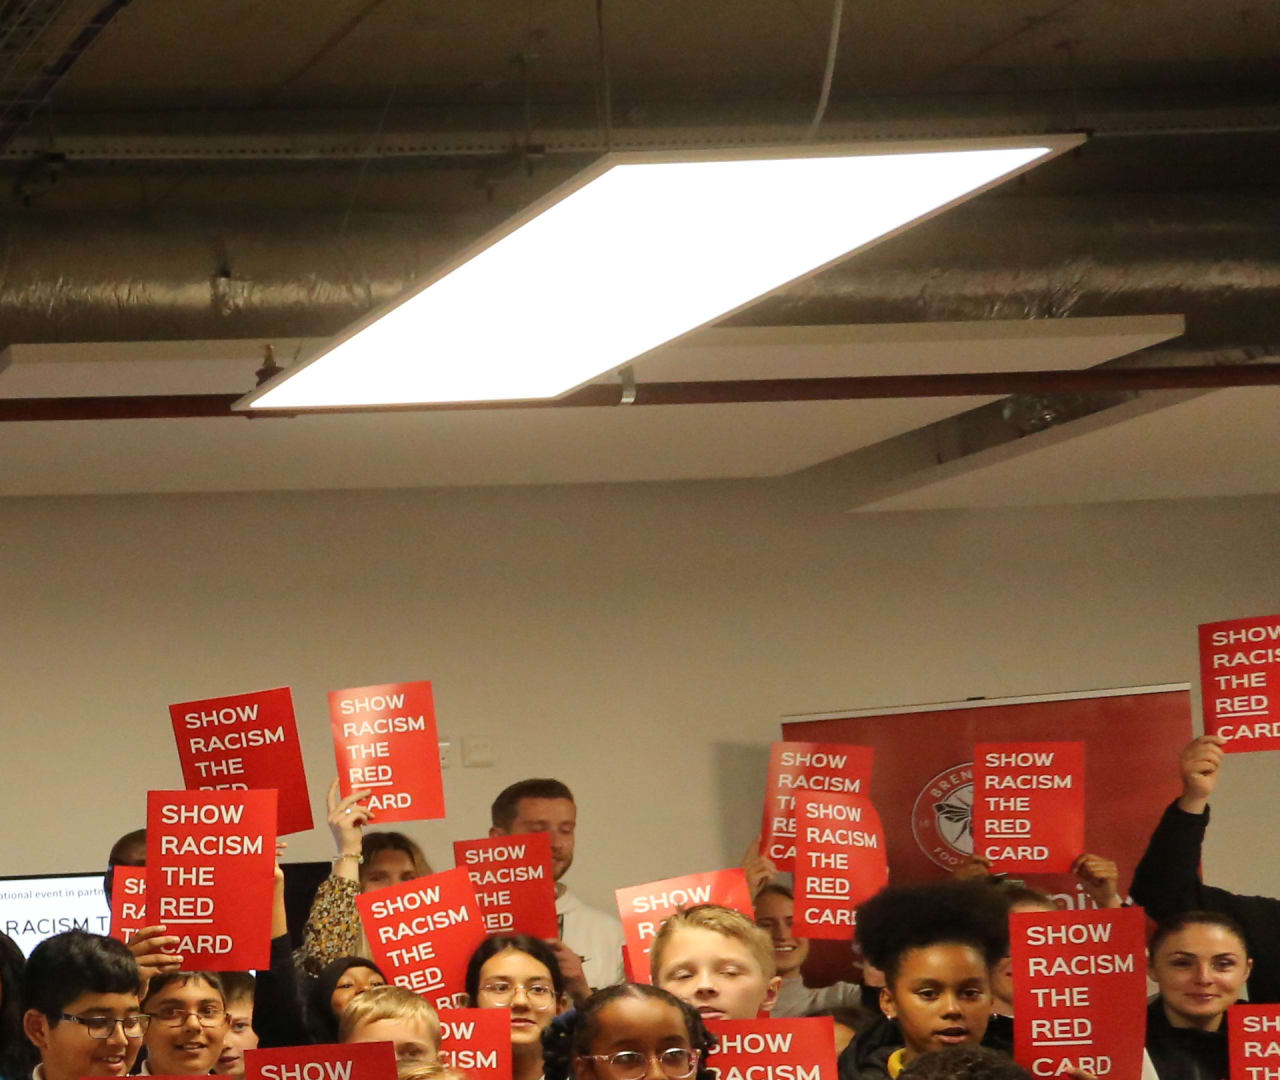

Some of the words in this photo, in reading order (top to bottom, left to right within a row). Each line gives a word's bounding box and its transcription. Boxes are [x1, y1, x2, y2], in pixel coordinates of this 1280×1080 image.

[986, 753, 1054, 767] SHOW
[986, 775, 1071, 789] RACISM
[806, 803, 861, 822] SHOW
[985, 798, 1030, 811] THE
[162, 805, 243, 823] SHOW
[985, 819, 1030, 832] RED
[162, 836, 262, 855] RACISM
[807, 828, 877, 848] RACISM
[808, 852, 848, 869] THE
[986, 846, 1048, 860] CARD
[162, 867, 214, 885] THE
[807, 877, 849, 893] RED
[35, 890, 62, 899] event
[66, 889, 74, 897] in
[161, 898, 213, 916] RED
[6, 917, 89, 935] RACISM
[1027, 923, 1111, 945] SHOW
[1029, 954, 1133, 976] RACISM
[1031, 987, 1089, 1007] THE
[1032, 1019, 1091, 1038] RED
